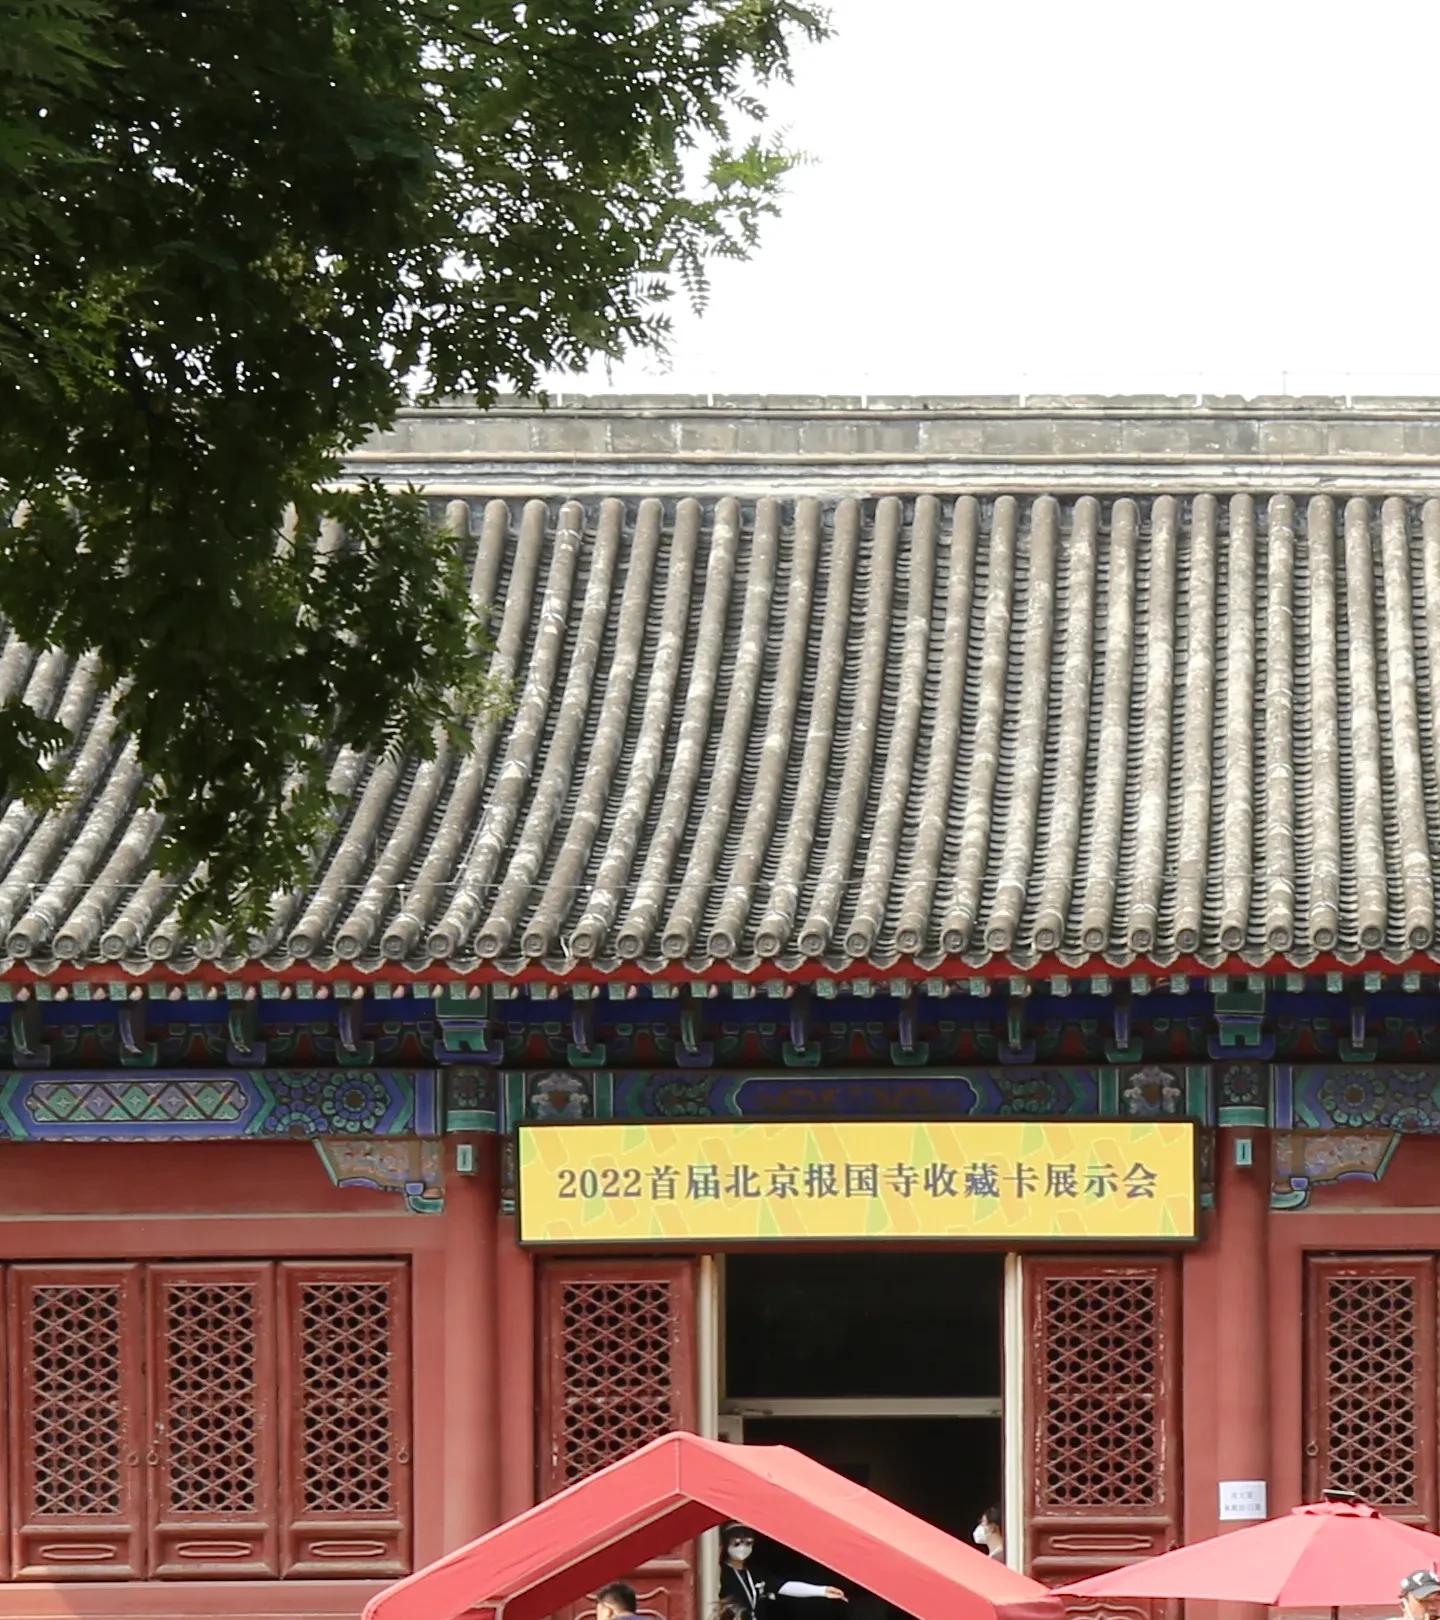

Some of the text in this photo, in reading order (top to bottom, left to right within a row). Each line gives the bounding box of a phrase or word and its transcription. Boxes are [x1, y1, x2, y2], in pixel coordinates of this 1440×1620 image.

[558, 1162, 1157, 1200] 2022首届北京报国寺收藏卡展示会
